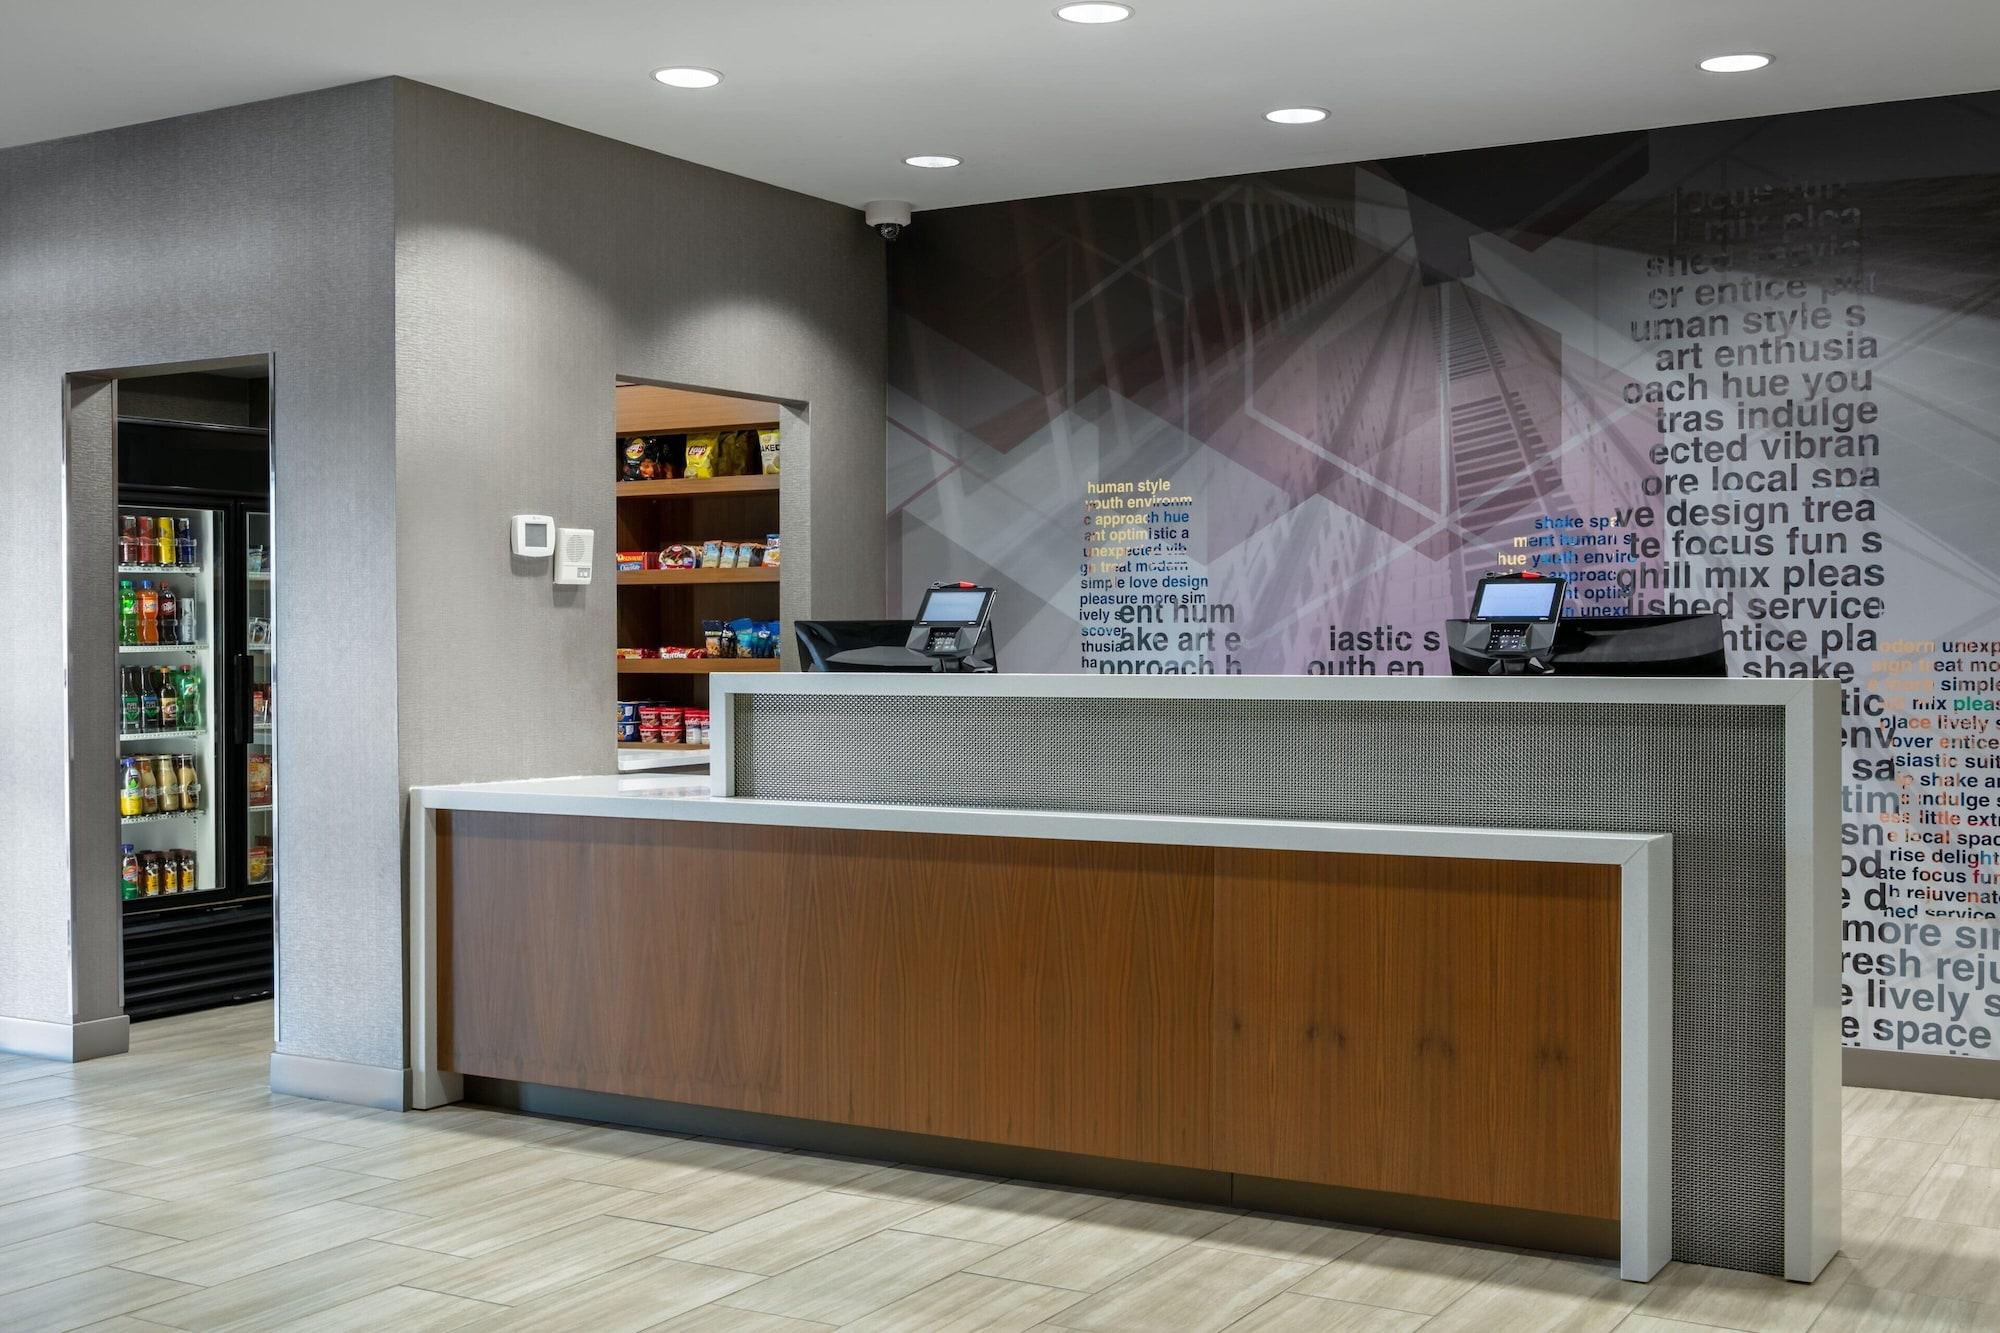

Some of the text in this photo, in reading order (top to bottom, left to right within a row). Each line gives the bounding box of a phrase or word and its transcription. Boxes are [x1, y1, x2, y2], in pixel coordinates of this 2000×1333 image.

[1648, 285, 1684, 309] or
[1695, 273, 1807, 305] entice
[1630, 302, 1867, 342] uman style s
[1655, 331, 1879, 371] art enthusia
[1622, 369, 1873, 404] oach hue you
[1656, 398, 1879, 434] tras indulge
[1649, 430, 1880, 465] ected vibran
[1087, 478, 1171, 495] human style
[1641, 472, 1699, 496] ore
[1711, 463, 1798, 493] local
[1095, 511, 1159, 528] approach
[1163, 511, 1190, 523] hue
[1535, 514, 1584, 529] shake
[1666, 498, 1789, 532] design
[1801, 496, 1876, 523] trea
[1109, 526, 1177, 543] optimistic
[1181, 529, 1190, 539] a
[1630, 526, 1883, 558] te focus fun s
[1498, 552, 1527, 565] hue
[1080, 575, 1209, 592] simple love design
[1705, 565, 1770, 589] mix
[1783, 558, 1885, 596] pleas
[1080, 592, 1138, 607] pleasure
[1181, 591, 1206, 604] sim
[1120, 597, 1235, 624] ent hum
[1747, 590, 1885, 620] service
[1079, 608, 1110, 623] ively
[1081, 626, 1127, 637] scover
[1120, 626, 1242, 652] ake art e
[1330, 625, 1440, 651] iastic s
[1821, 622, 1877, 659] pla
[1081, 640, 1123, 653] thusia
[1081, 656, 1097, 668] ha
[1226, 655, 1242, 675] h
[1307, 655, 1424, 675] outh en
[1742, 655, 1855, 684] shake
[1937, 715, 1990, 734] lively
[1852, 758, 1895, 782] sa
[1920, 772, 1978, 788] shake
[1919, 809, 1961, 825] little
[1967, 813, 2000, 828] ext
[1890, 847, 1926, 862] rise
[1878, 867, 1906, 881] ate
[1912, 866, 1967, 883] focus
[1907, 886, 2000, 905] rejuvenat
[1842, 919, 2000, 950] more si
[1867, 978, 1970, 1022] lively
[1873, 1018, 1992, 1051] space
